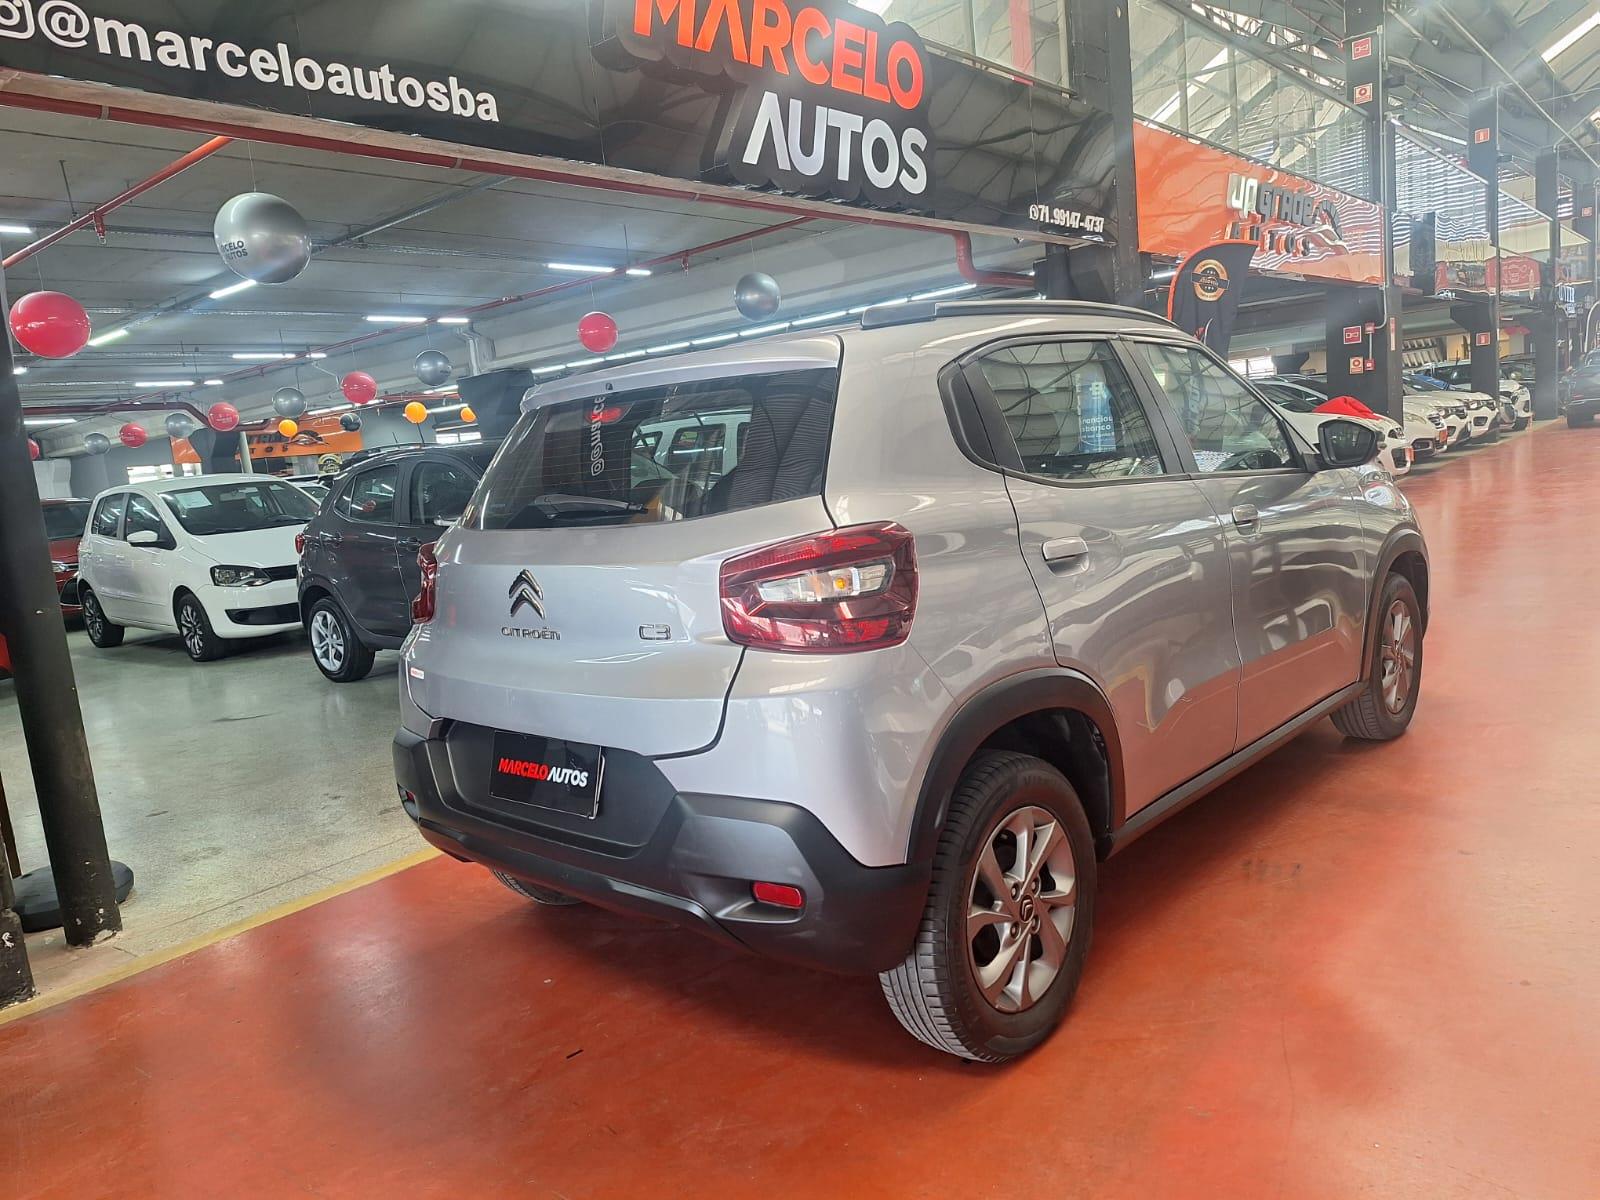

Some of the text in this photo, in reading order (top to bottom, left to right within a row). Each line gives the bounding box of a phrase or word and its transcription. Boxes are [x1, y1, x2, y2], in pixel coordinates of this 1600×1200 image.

[37, 0, 499, 122] @marceloautosba
[633, 0, 924, 110] MARCELO
[742, 91, 928, 194] AUTOS
[501, 626, 561, 641] CITROËN
[638, 624, 671, 640] C3
